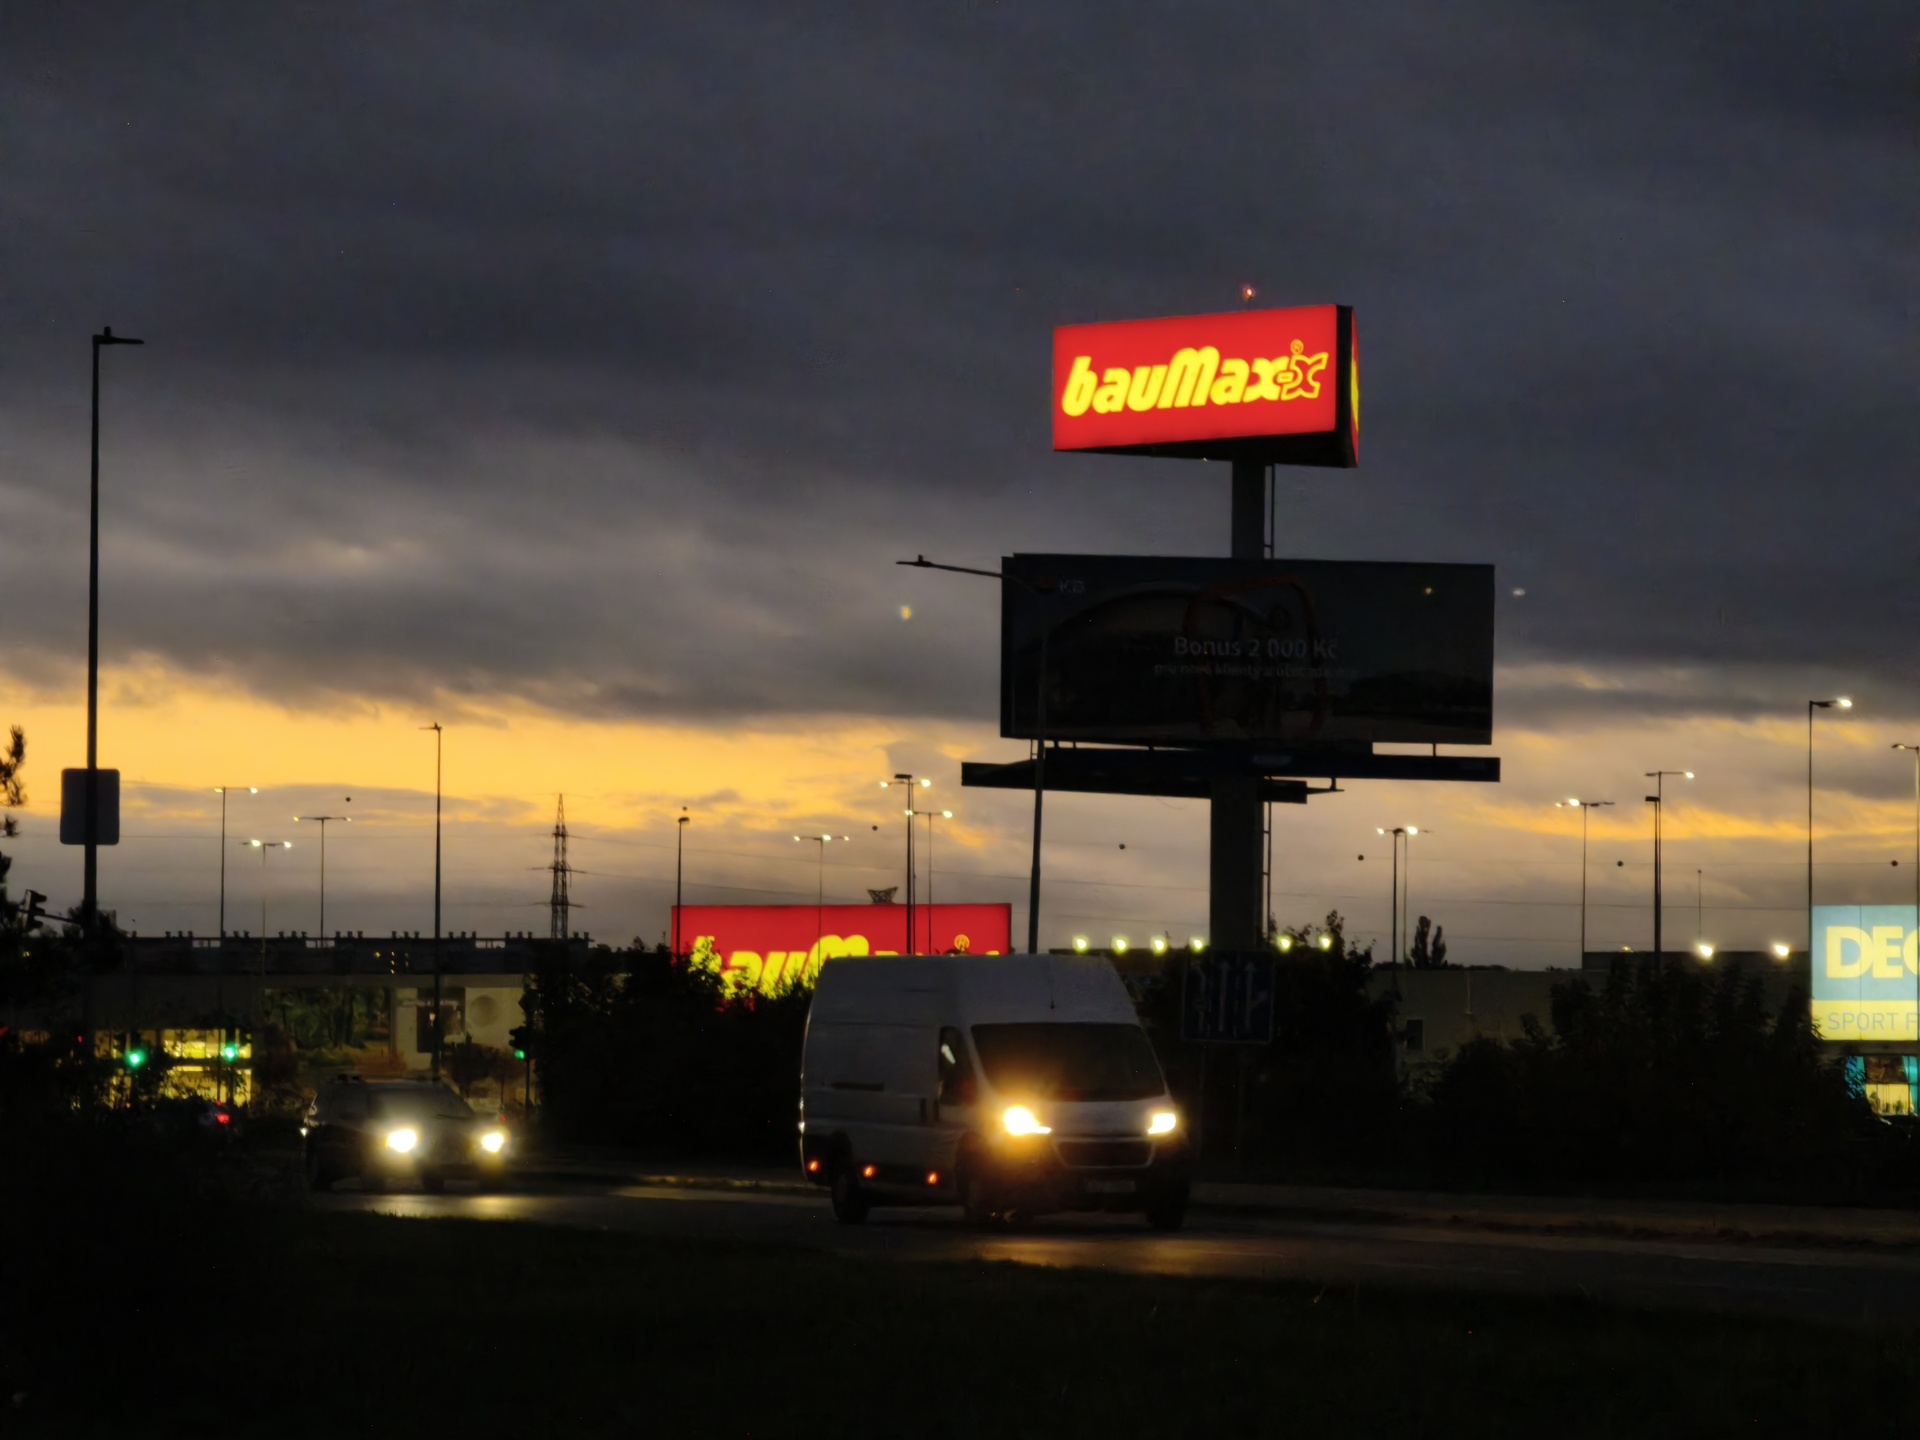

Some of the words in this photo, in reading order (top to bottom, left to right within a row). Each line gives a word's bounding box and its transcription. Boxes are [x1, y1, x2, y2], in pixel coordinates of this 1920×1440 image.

[1174, 636, 1241, 657] Bonus
[1247, 638, 1260, 657] 2
[1828, 1012, 1898, 1031] SPORT
